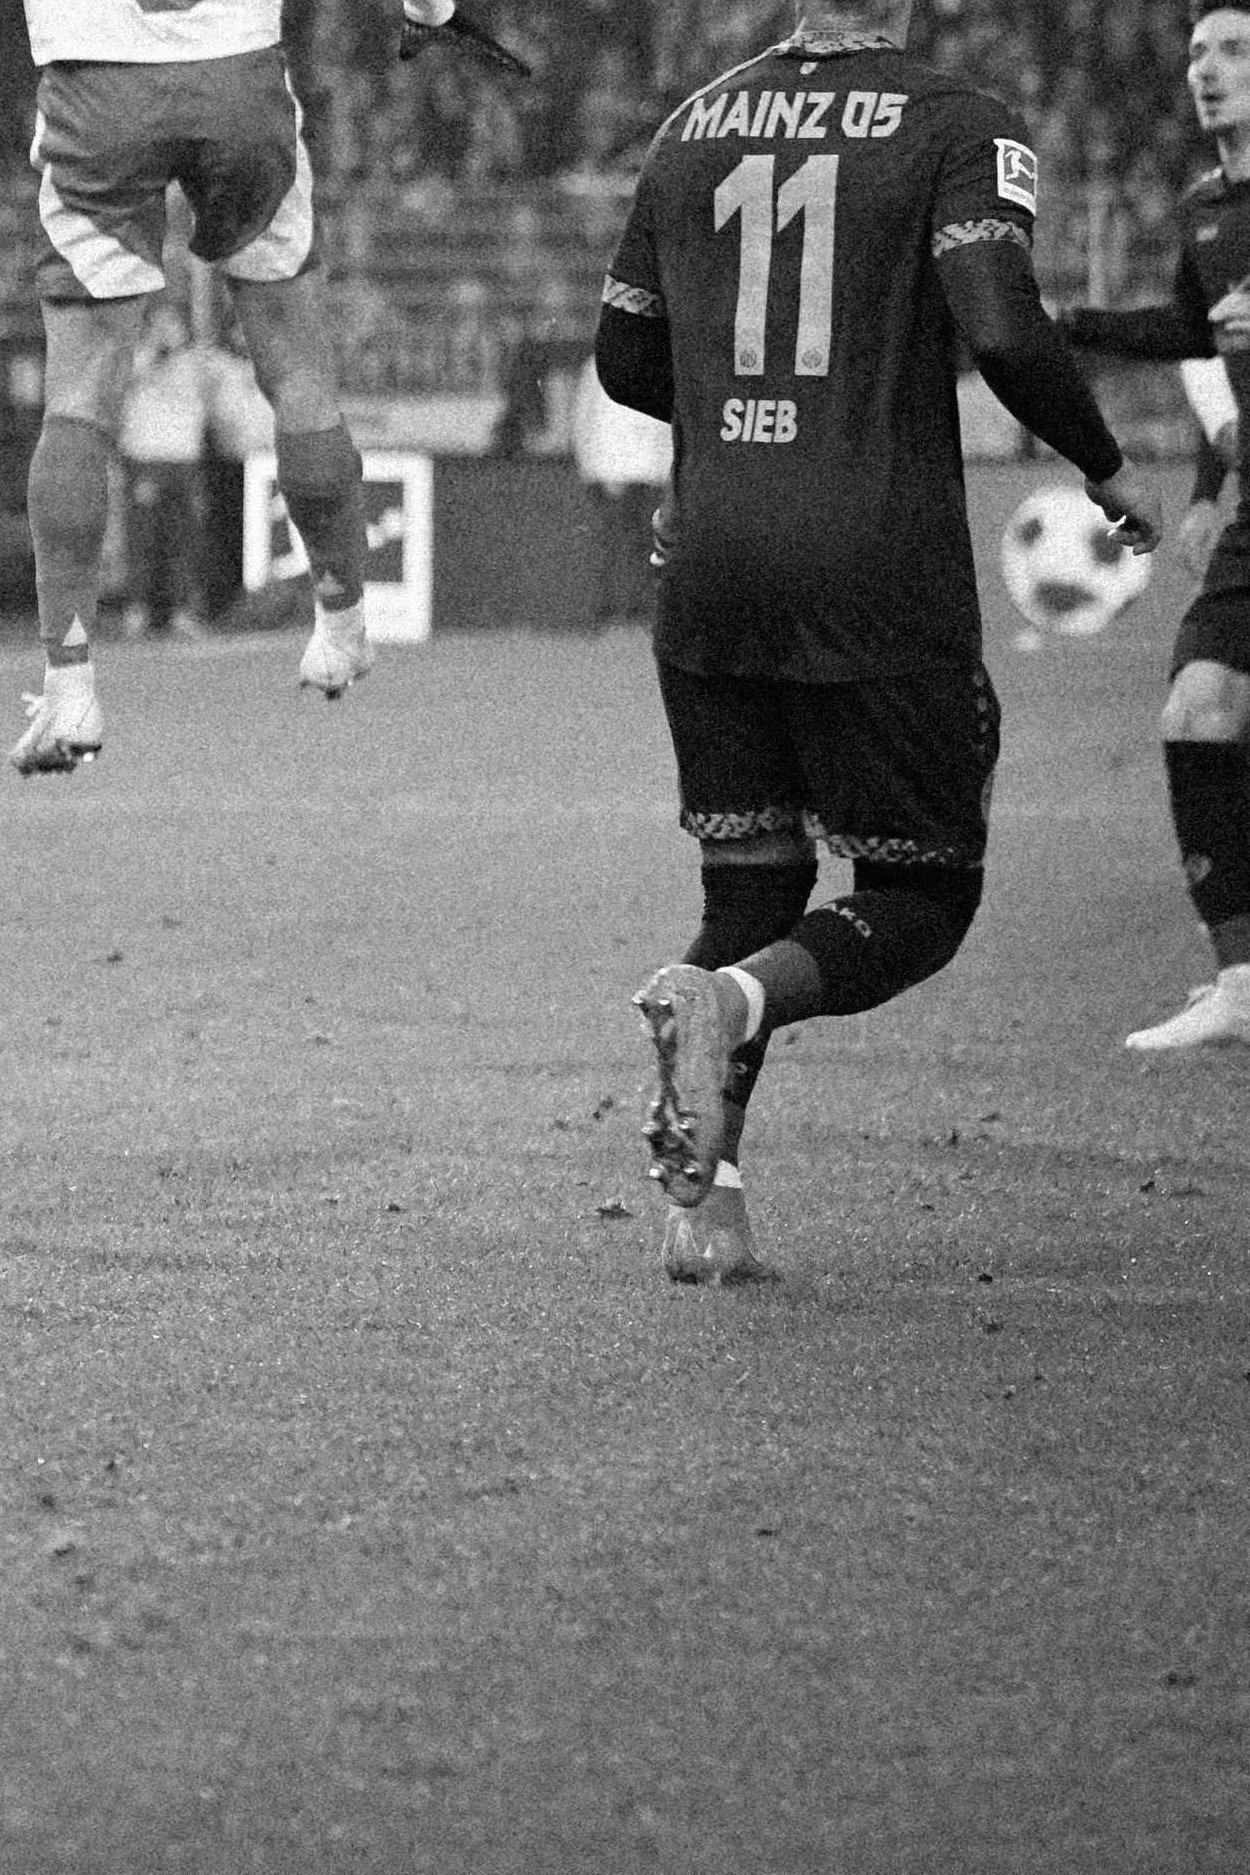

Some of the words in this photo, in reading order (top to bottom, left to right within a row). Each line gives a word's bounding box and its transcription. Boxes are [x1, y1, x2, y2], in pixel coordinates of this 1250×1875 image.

[681, 90, 837, 143] MAINZ
[841, 90, 910, 139] 05
[713, 153, 840, 377] 11
[720, 397, 798, 443] SIEB
